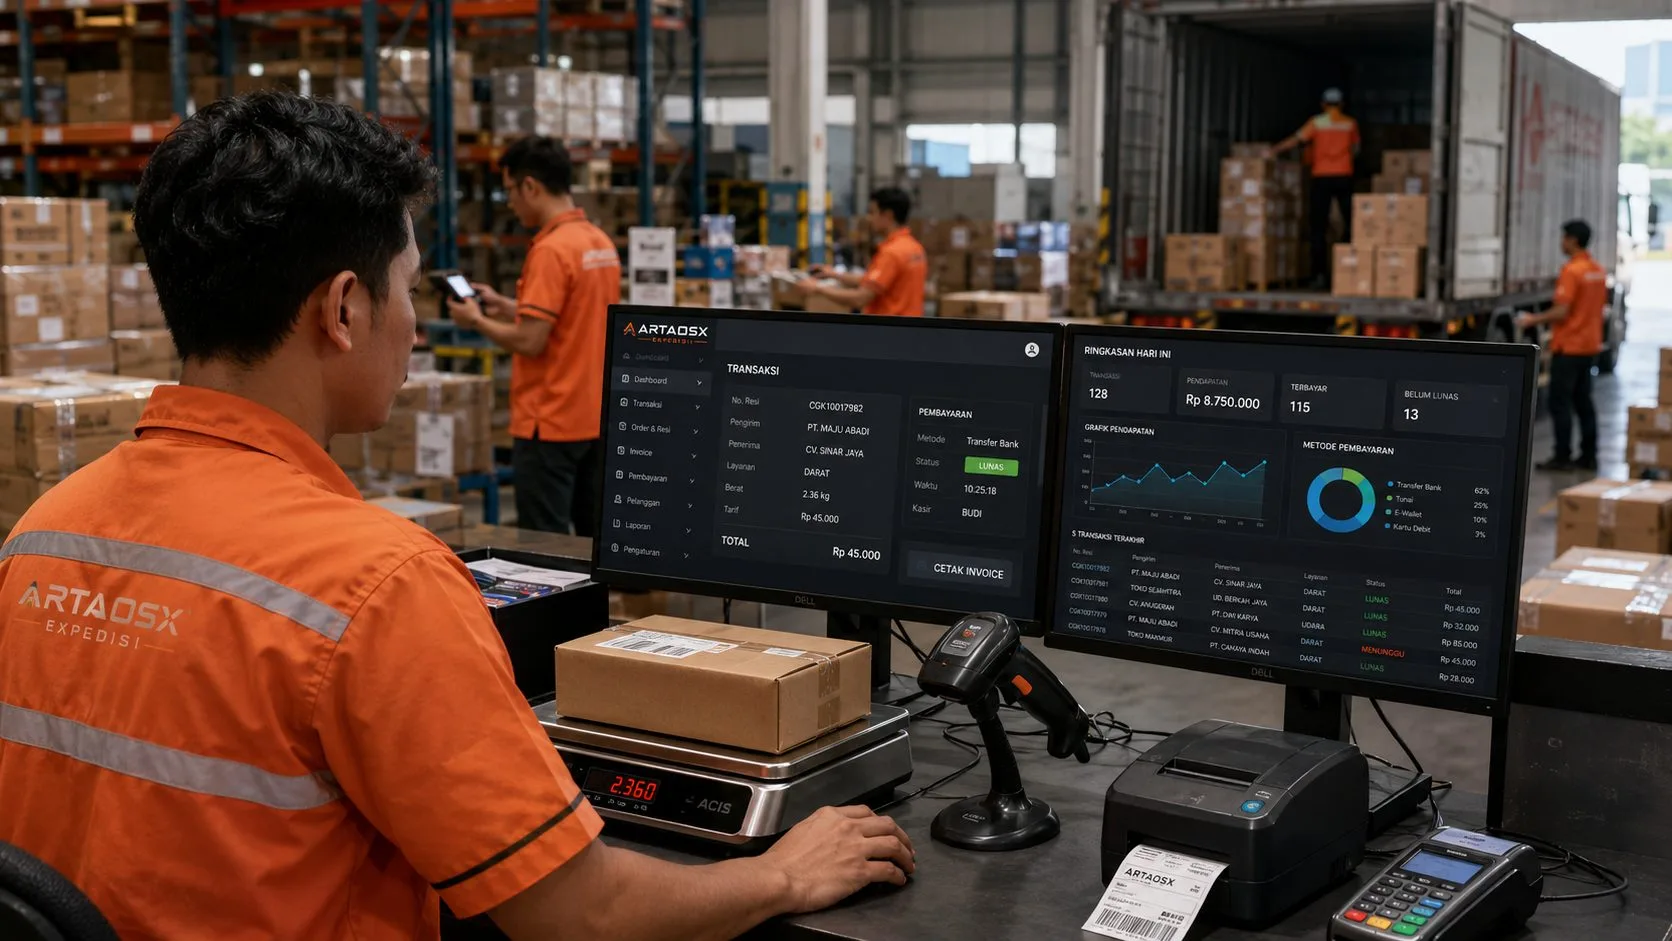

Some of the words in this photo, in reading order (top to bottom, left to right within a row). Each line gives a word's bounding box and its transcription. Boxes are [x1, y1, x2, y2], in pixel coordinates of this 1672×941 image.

[1085, 346, 1134, 356] RINGKASAN
[1137, 349, 1157, 357] HARI
[1159, 350, 1171, 358] INI
[728, 364, 779, 375] TRANSAKSI
[635, 376, 667, 384] Dashboard
[1291, 384, 1327, 392] TERBAYAR
[1090, 388, 1107, 399] 128
[634, 399, 662, 408] Transaksi
[745, 397, 759, 405] Resi
[1186, 394, 1200, 407] Rp
[1204, 395, 1260, 409] 8.750.000
[809, 401, 863, 412] CGK10017982
[1291, 401, 1310, 412] 115
[919, 408, 972, 418] PEMBAYARAN
[1404, 409, 1418, 420] 13
[821, 424, 843, 433] MAJU
[845, 427, 869, 435] ABADI
[1110, 426, 1154, 435] PENDAPATAN
[917, 434, 945, 443] Metode
[967, 437, 997, 446] Transfer
[1000, 440, 1018, 448] Bank
[729, 440, 760, 449] Penerima
[1303, 441, 1336, 450] METODE
[1339, 444, 1394, 455] PEMBAYARAN
[630, 448, 652, 456] Invoice
[806, 446, 818, 454] CV.
[820, 447, 843, 455] SINAR
[845, 449, 864, 457] JAYA
[727, 462, 755, 471] Layanan
[916, 457, 939, 466] Status
[979, 462, 1004, 471] LUNAS
[629, 472, 667, 483] Pembayaran
[804, 468, 830, 477] DARAT
[725, 483, 743, 492] Berat
[1397, 481, 1423, 489] Transfer
[803, 490, 818, 499] 2.36
[821, 492, 830, 501] kg
[627, 497, 660, 507] Pelanggan
[724, 505, 739, 513] Tarif
[913, 504, 931, 512] Kasir
[962, 508, 982, 517] BUDI
[1395, 509, 1422, 517] E-Wallet
[801, 512, 811, 522] Rp
[813, 514, 839, 523] 45.000
[626, 522, 651, 530] Laporan
[722, 536, 749, 547] TOTAL
[833, 547, 845, 558] Rp
[848, 549, 880, 560] 45.000
[934, 564, 964, 574] CETAK
[966, 567, 1004, 579] INVOICE
[1366, 579, 1385, 587] Status
[1304, 588, 1326, 596] DARAT
[795, 594, 817, 606] DELL
[1365, 596, 1389, 604] LUNAS
[18, 579, 185, 638] ARTAOSX
[1303, 605, 1325, 613] DARAT
[1445, 604, 1454, 612] Rp
[1455, 606, 1480, 614] 45.000
[1139, 617, 1157, 625] MAJU
[1364, 613, 1387, 621] LUNAS
[1443, 621, 1453, 629] Rp
[1455, 623, 1479, 632] 32.000
[44, 619, 140, 650] EXPEDISI
[1363, 629, 1388, 639] LUNAS
[1301, 638, 1323, 646] DARAT
[1442, 639, 1451, 647] Rp
[1361, 646, 1404, 657] MENUNGGU
[1300, 655, 1322, 663] DARAT
[1441, 656, 1450, 664] Rp
[1452, 658, 1476, 667] 45.000
[1360, 663, 1384, 672] LUNAS
[1440, 673, 1448, 681] Rp
[1450, 675, 1474, 684] 28.000
[610, 775, 657, 801] 2.360
[697, 798, 732, 814] ACIS
[1124, 868, 1176, 887] ARTAOSX
